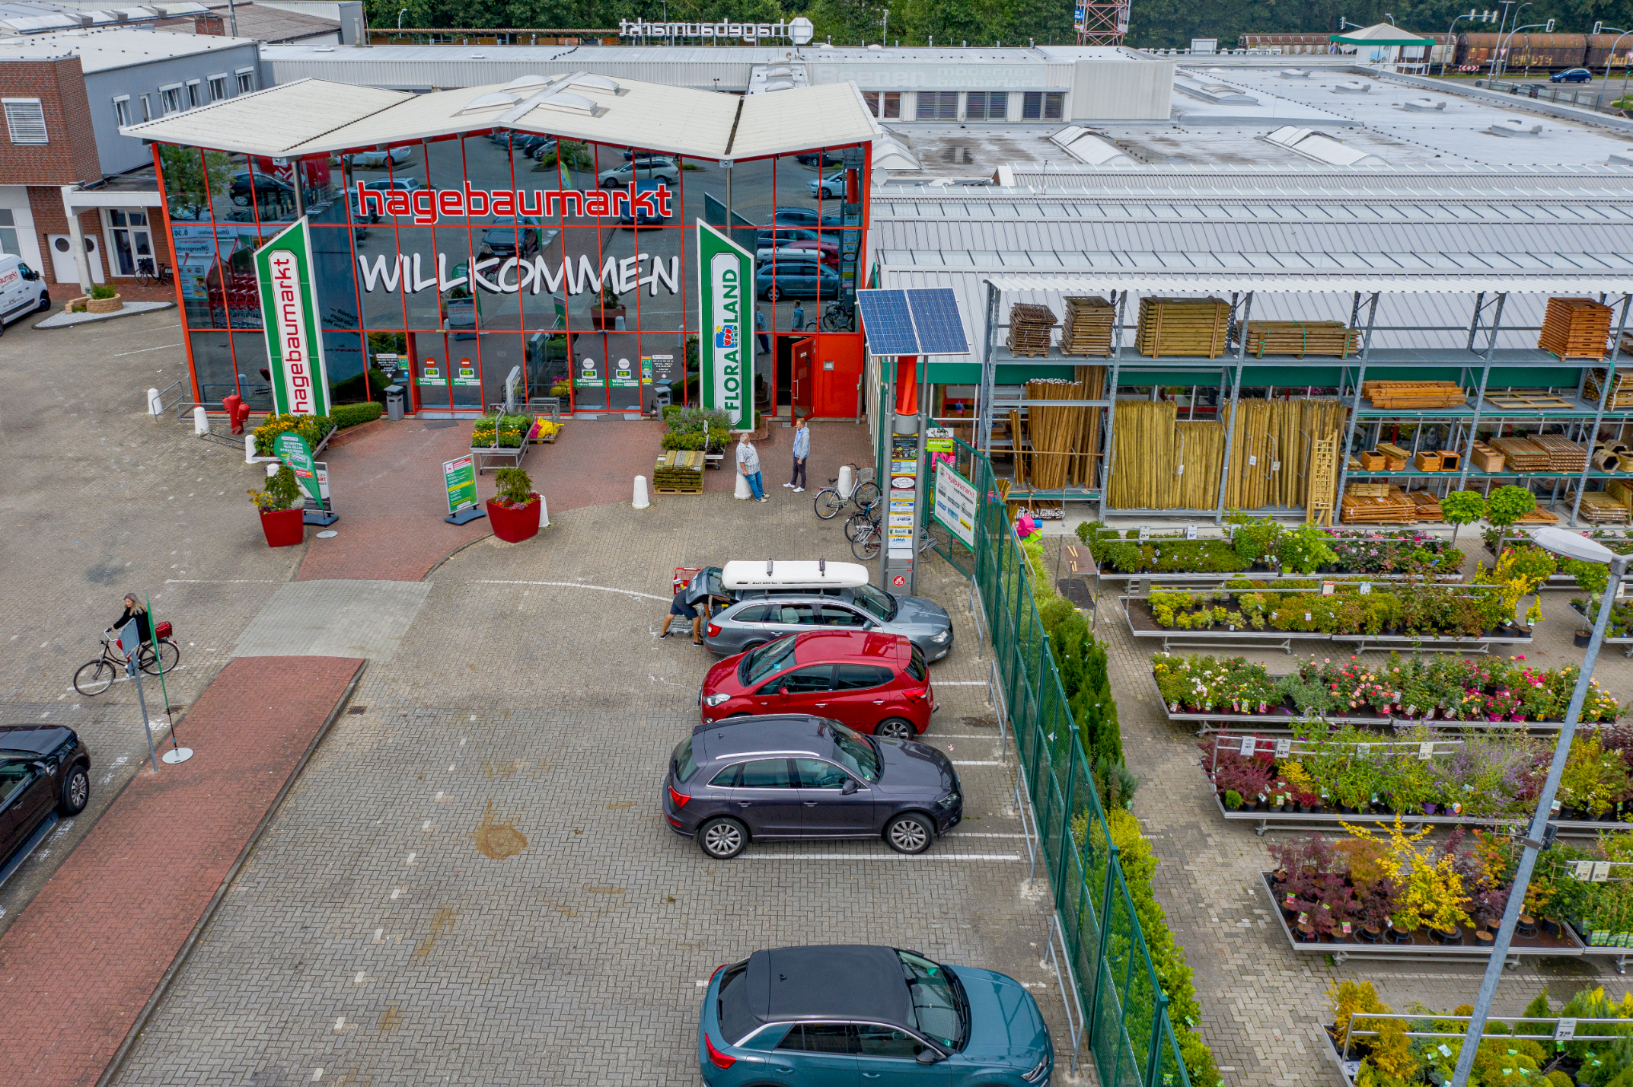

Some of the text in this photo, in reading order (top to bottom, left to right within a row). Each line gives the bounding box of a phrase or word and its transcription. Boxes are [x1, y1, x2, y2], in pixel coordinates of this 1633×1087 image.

[356, 180, 673, 225] hagebaumarkt
[358, 252, 680, 296] WILLKOMMEN
[722, 268, 739, 324] LAND
[273, 258, 310, 413] hagebaumarkt
[724, 349, 740, 411] FLORA
